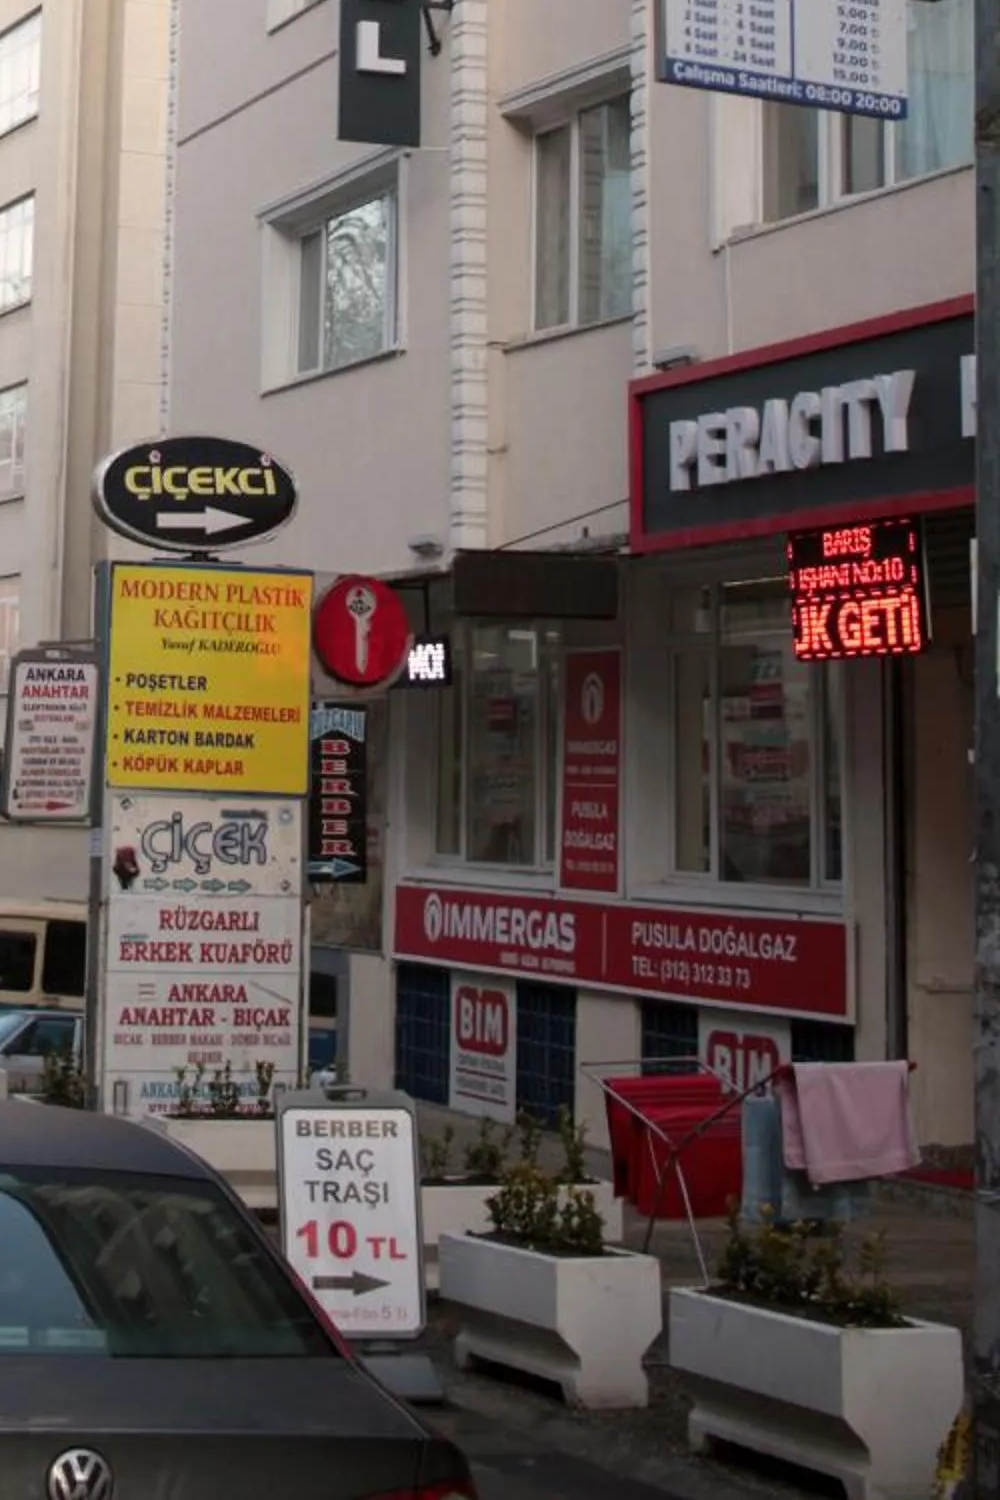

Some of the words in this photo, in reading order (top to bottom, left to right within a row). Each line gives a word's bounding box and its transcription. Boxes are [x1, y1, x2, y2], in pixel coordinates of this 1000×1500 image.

[672, 62, 735, 87] Çalışma
[805, 84, 852, 105] 08:00
[855, 92, 901, 114] 20:00
[669, 369, 917, 492] PERACITY
[124, 450, 277, 501] ÇİÇEKCİ
[852, 557, 904, 585] NO:10
[120, 578, 219, 601] MODERN
[226, 583, 306, 609] PLASTİK
[153, 605, 276, 635] KAĞITÇILIK
[25, 667, 86, 681] ANKARA
[125, 672, 208, 692] POŞETLER
[22, 684, 89, 699] ANAHTAR
[125, 699, 198, 720] TEMİZLİK
[203, 703, 301, 725] MALZEMELERİ
[123, 728, 189, 747] KARTON
[194, 730, 256, 749] BARDAK
[122, 754, 179, 774] KÖPÜK
[183, 758, 244, 777] KAPLAR
[320, 739, 360, 856] BERBER
[141, 811, 269, 874] ÇİÇEK
[444, 902, 577, 954] IMMERGAS
[631, 921, 697, 950] PUSULA
[698, 924, 797, 962] DOĞALGAZ
[119, 940, 193, 964] ERKEK
[199, 938, 294, 965] KUAFÖRÜ
[631, 955, 657, 978] TEL:
[660, 959, 690, 987] (312)
[692, 962, 714, 985] 312
[717, 965, 732, 987] 33
[735, 967, 752, 989] 73
[168, 983, 249, 1003] ANKARA
[118, 1007, 216, 1027] ANAHTAR
[232, 1007, 292, 1032] BIÇAK
[295, 1118, 399, 1139] BERBER
[315, 1147, 376, 1177] SAÇ
[303, 1180, 390, 1210] TRAŞI
[295, 1219, 358, 1260] 10
[365, 1235, 407, 1260] TL
